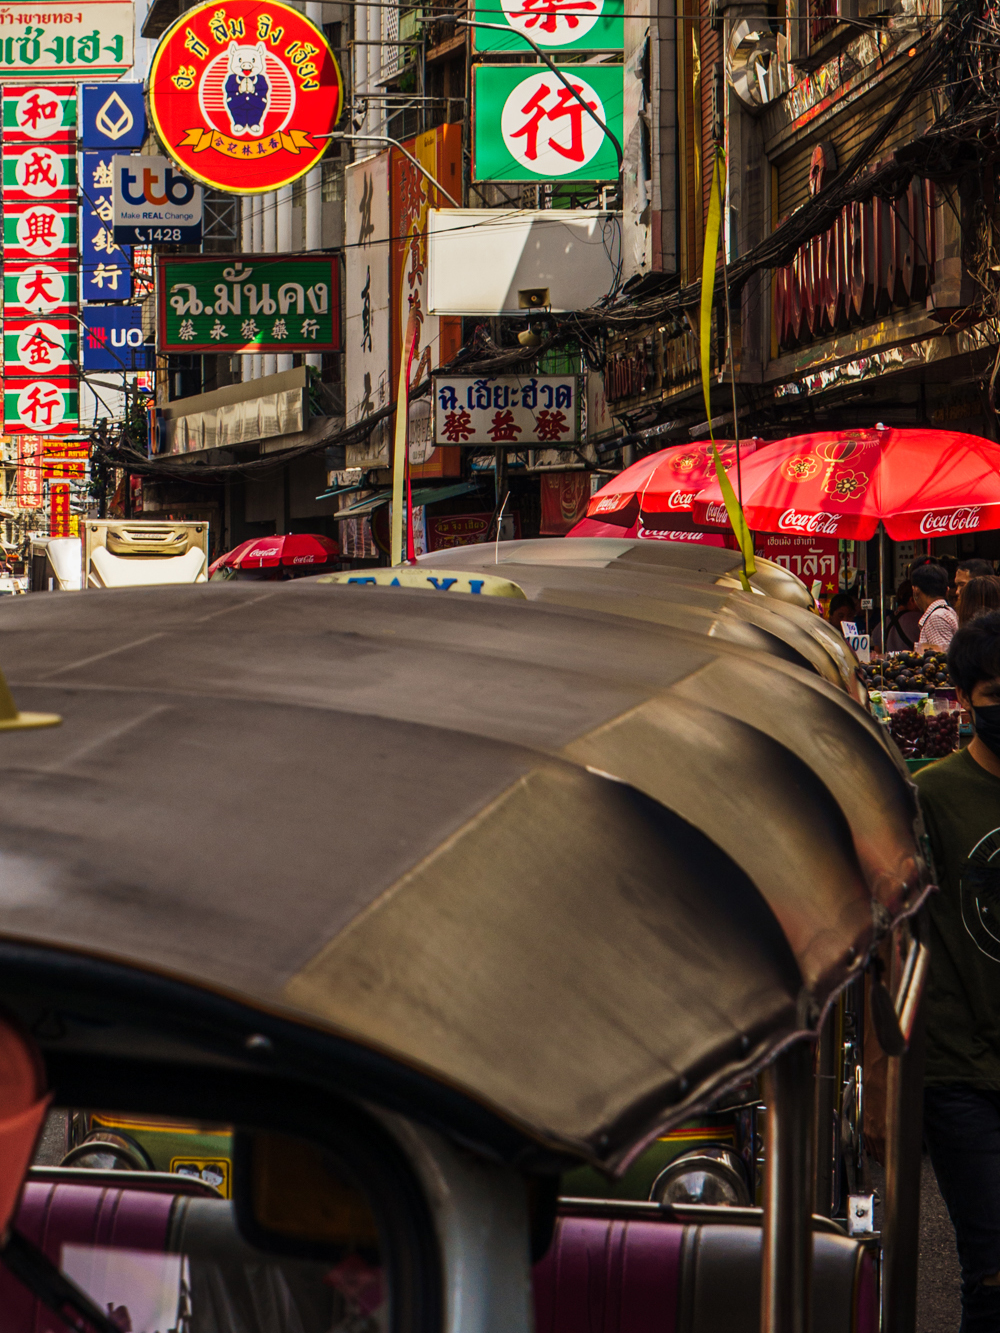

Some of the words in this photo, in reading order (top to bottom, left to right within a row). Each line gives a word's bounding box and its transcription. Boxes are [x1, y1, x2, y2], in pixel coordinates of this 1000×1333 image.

[121, 168, 194, 206] ttb
[121, 211, 140, 219] Make
[142, 211, 163, 219] REAL
[165, 211, 193, 220] Change
[147, 228, 181, 241] 1428
[20, 93, 60, 426] 和成興大金行
[170, 262, 328, 316] ฉ.มั่นคง
[111, 331, 149, 347] UO
[440, 410, 570, 443] 蔡益發
[668, 490, 704, 509] Coca-
[779, 508, 842, 534] Coca-Cola
[920, 507, 980, 534] Coca-Cola
